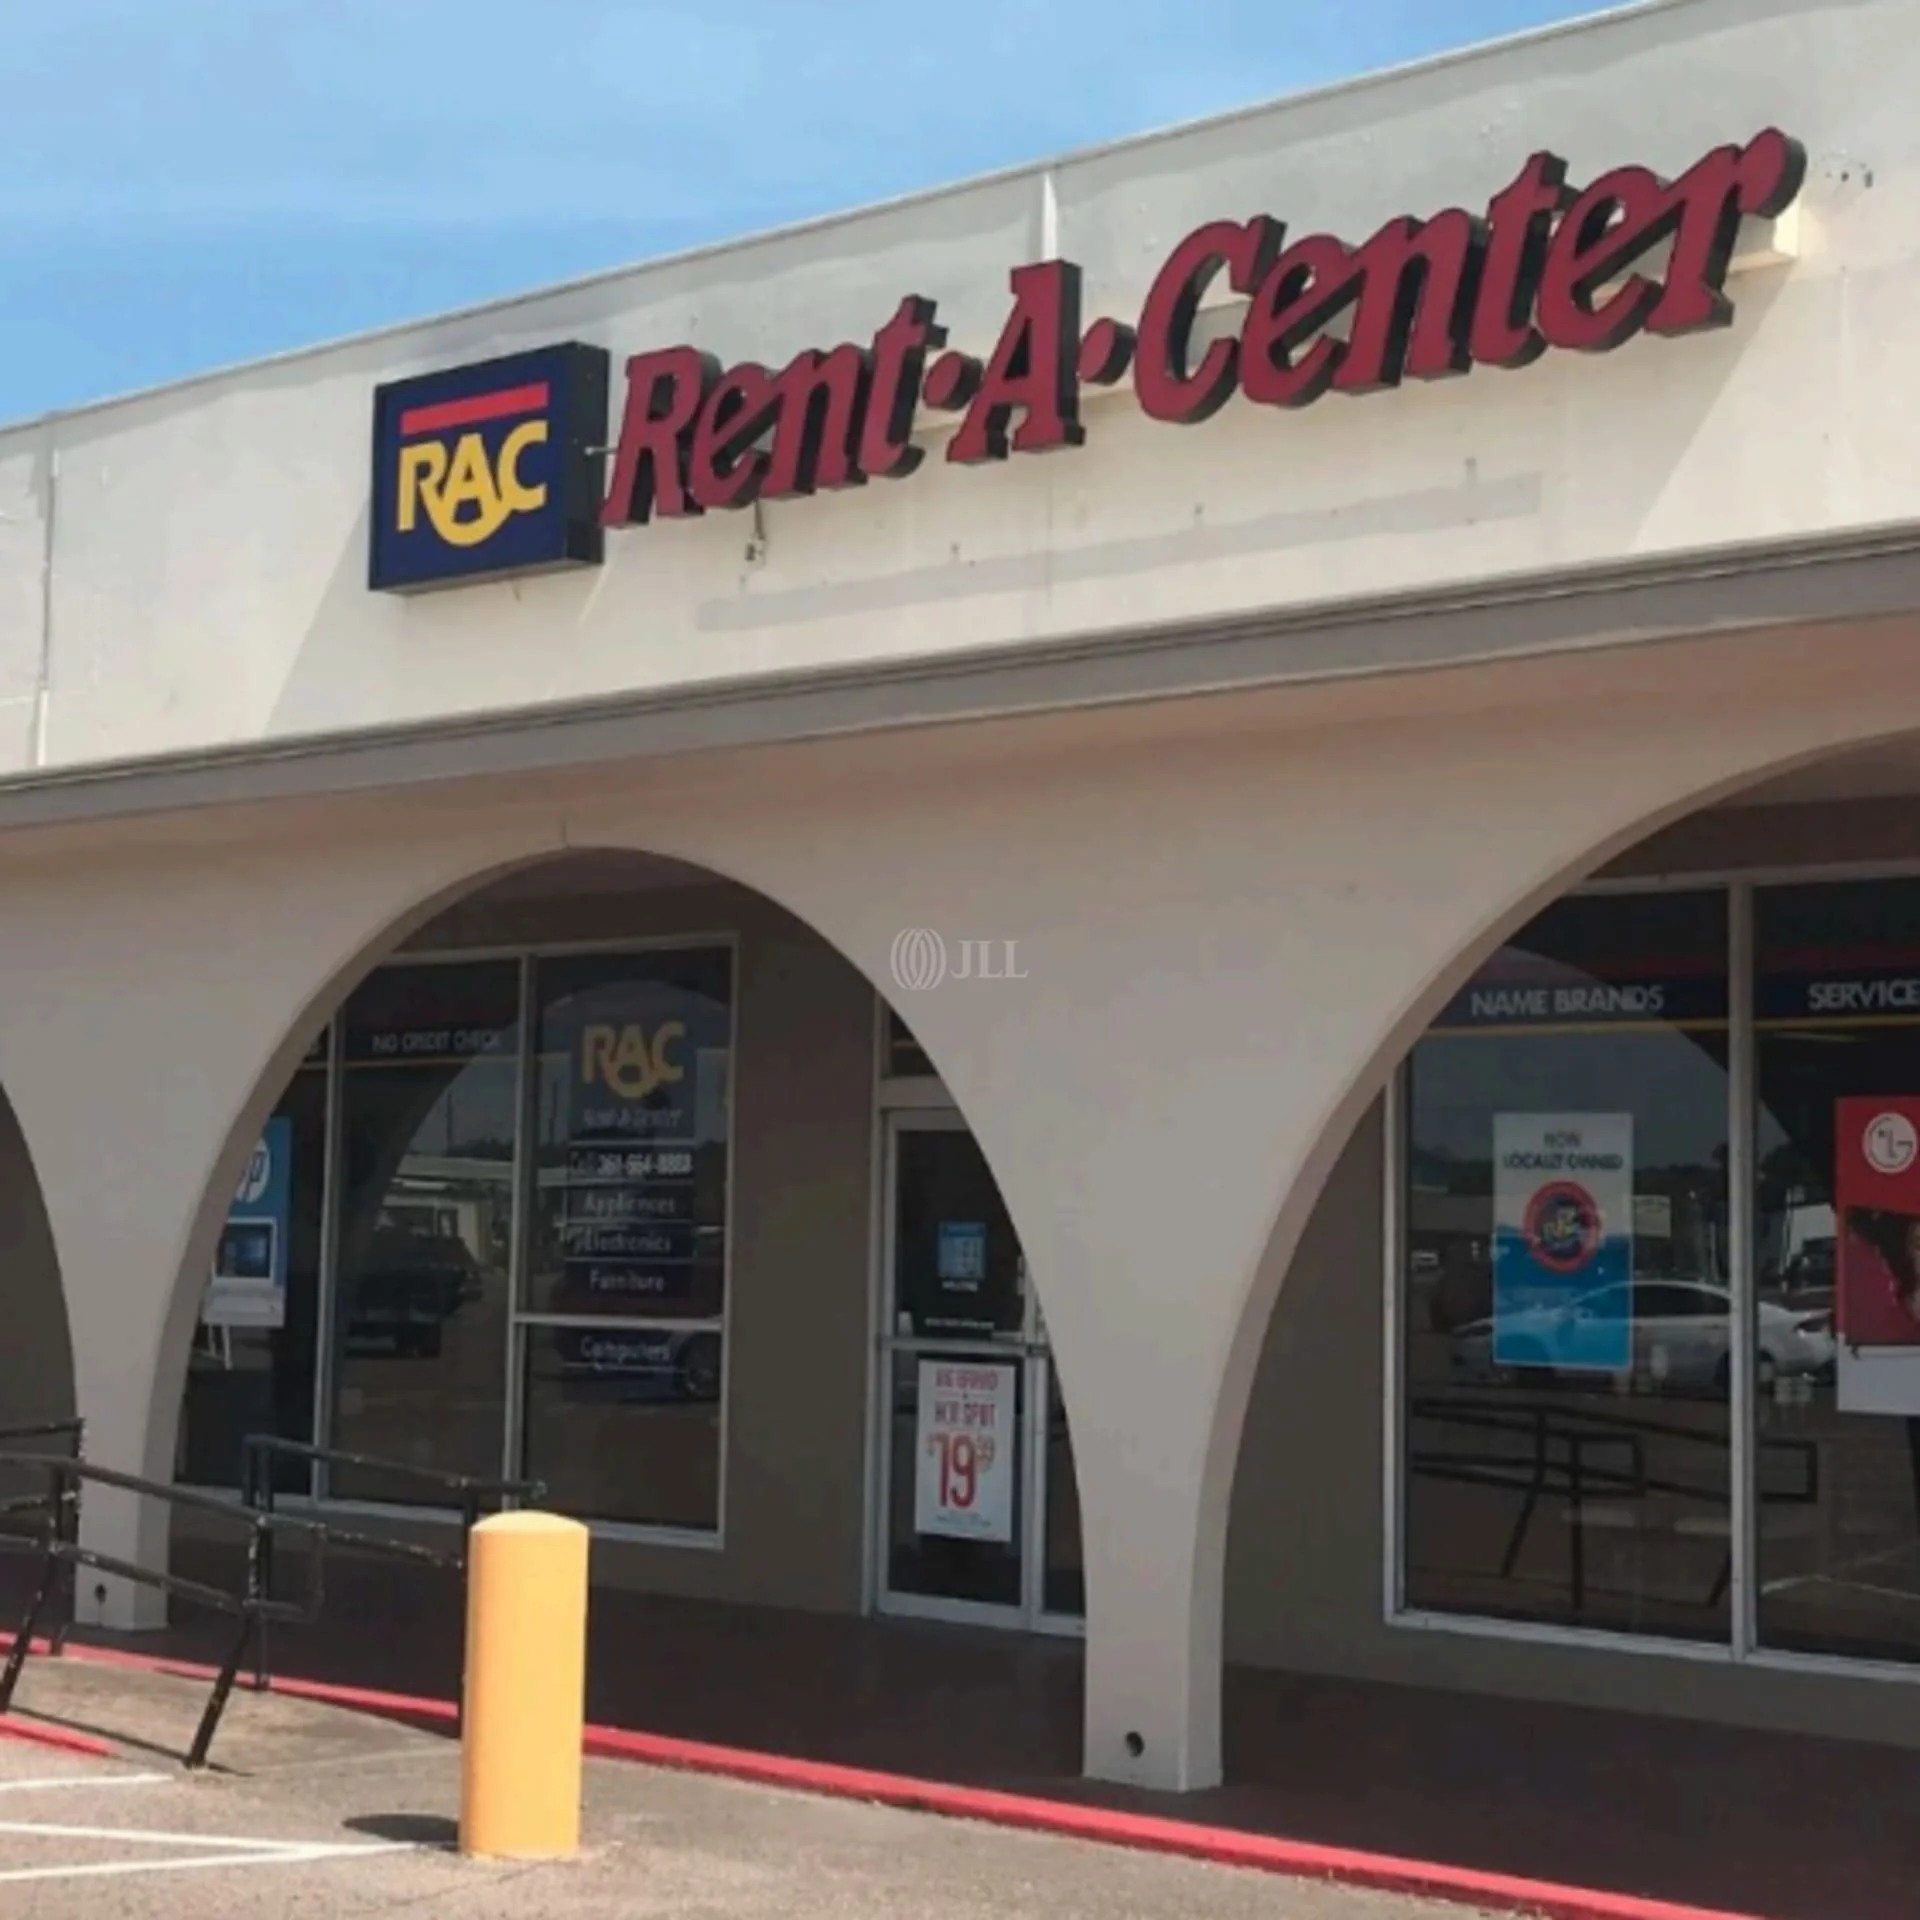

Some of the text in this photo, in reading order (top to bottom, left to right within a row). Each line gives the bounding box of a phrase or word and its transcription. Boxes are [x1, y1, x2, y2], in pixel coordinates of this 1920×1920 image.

[396, 420, 549, 548] RAC
[1471, 984, 1665, 1017] NAME BRANDS
[1807, 978, 1920, 1011] SERVICE
[372, 1028, 502, 1054] NO CREDIT CHECK
[581, 1020, 687, 1099] RAC
[1543, 1131, 1582, 1148] NOW
[1502, 1151, 1624, 1170] LOCALLY OWNED
